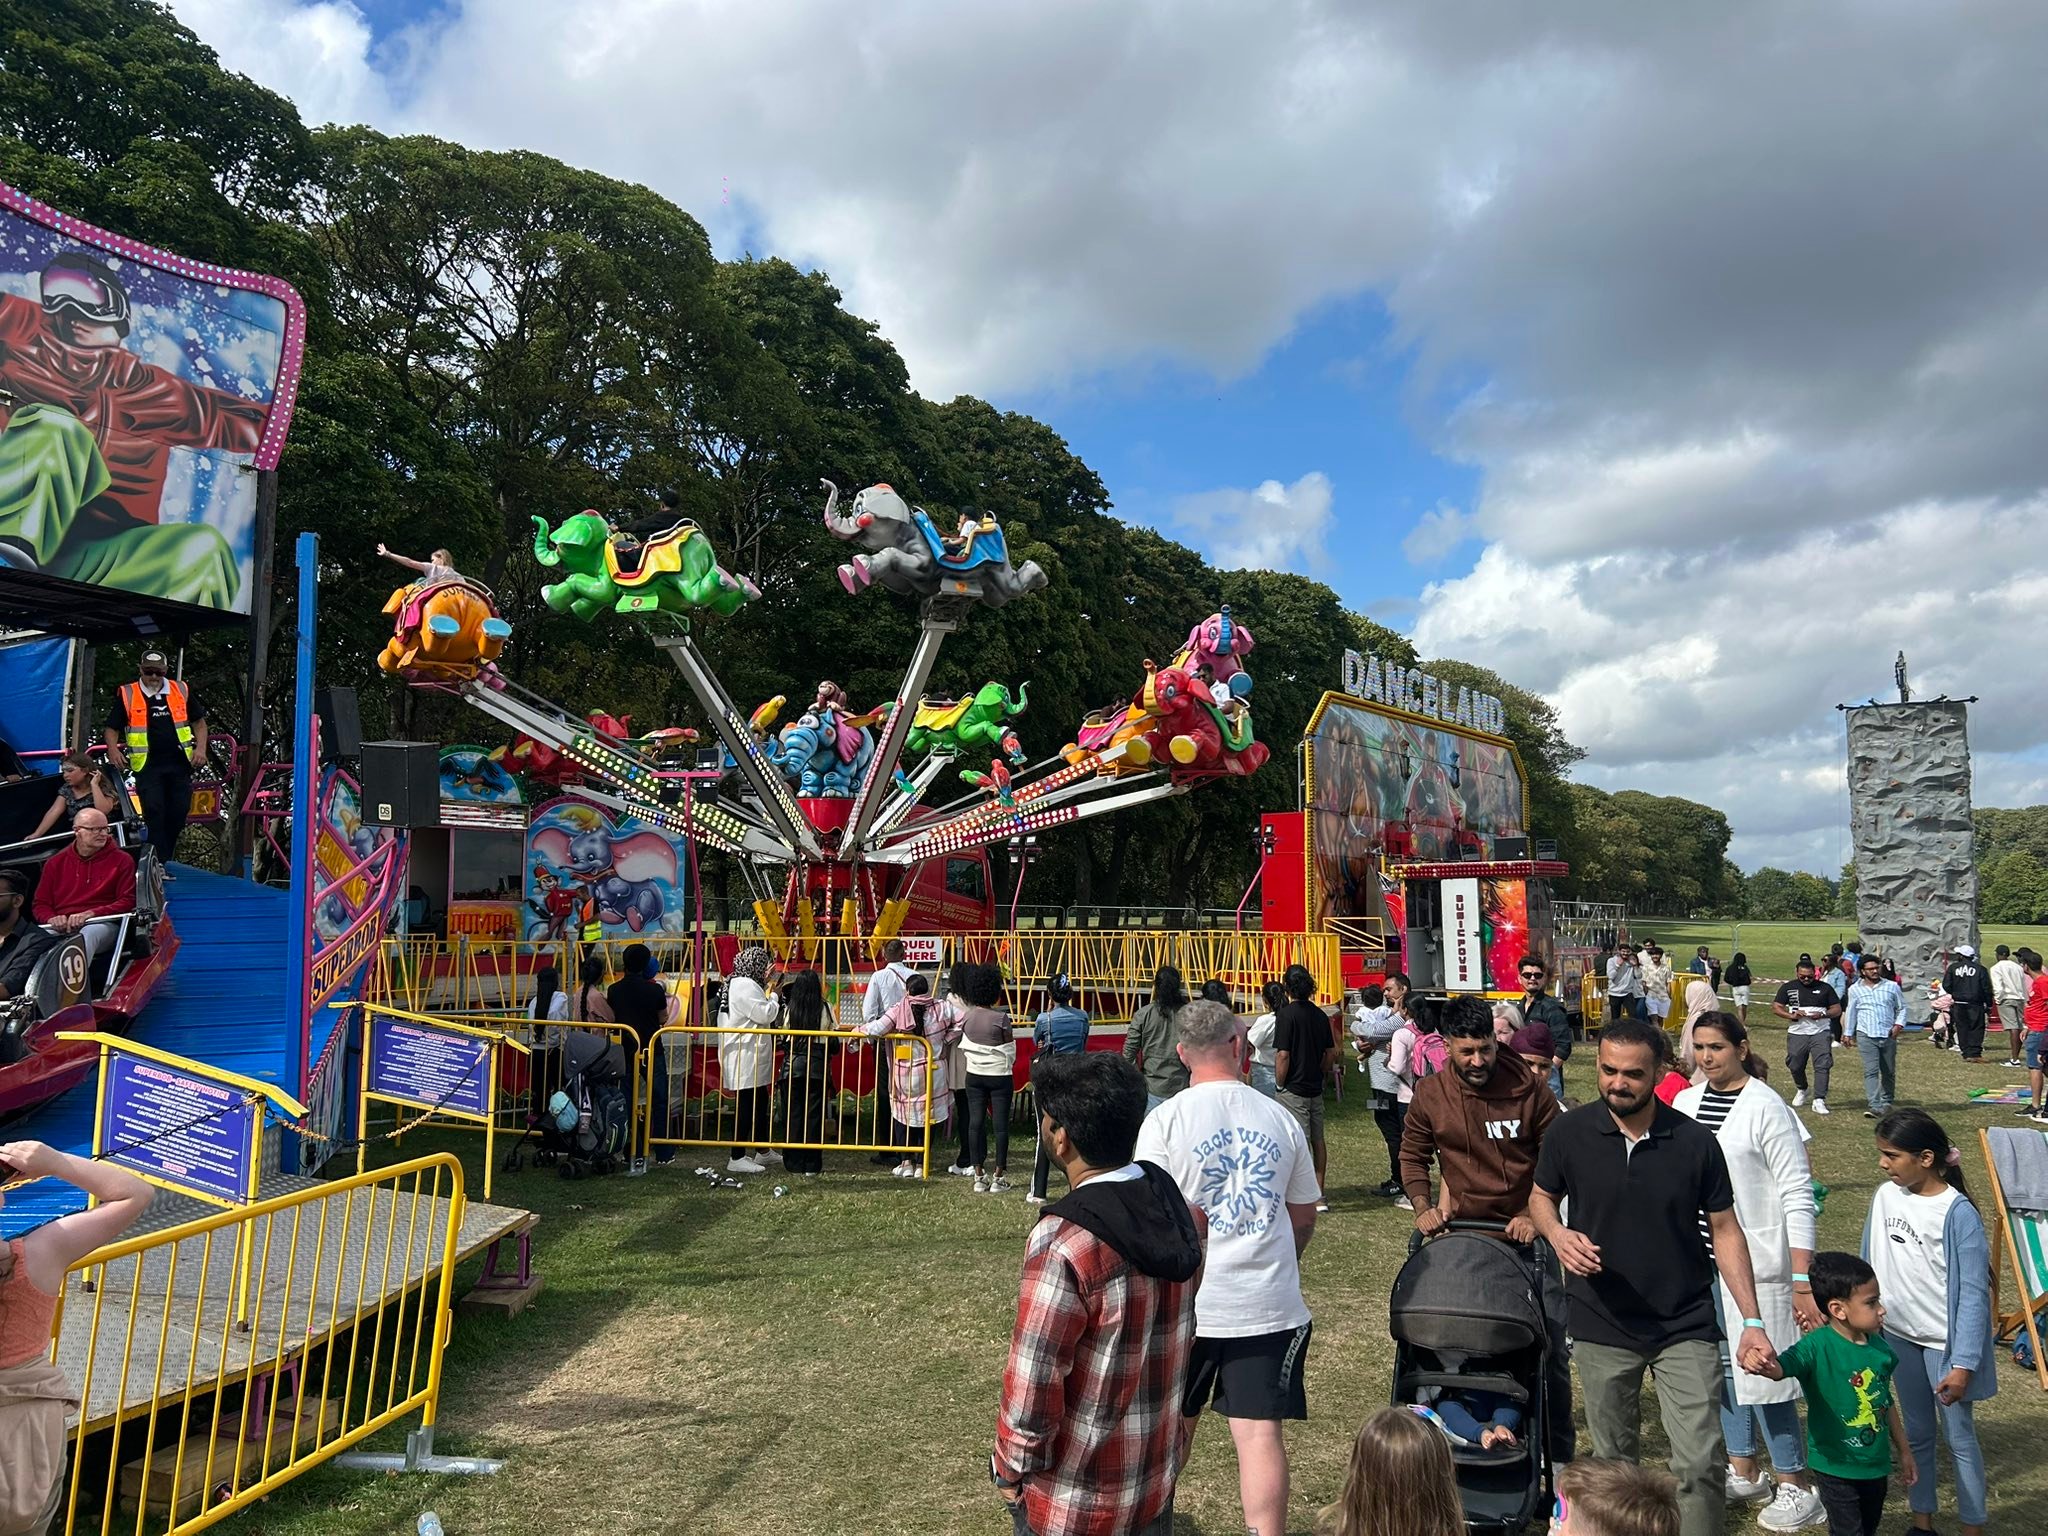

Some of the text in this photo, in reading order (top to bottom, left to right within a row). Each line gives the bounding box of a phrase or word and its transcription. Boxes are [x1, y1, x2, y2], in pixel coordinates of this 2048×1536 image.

[1344, 648, 1505, 735] DANCELAND
[380, 806, 390, 814] DS
[63, 954, 84, 985] 19
[312, 914, 378, 1002] SUPERBOB
[904, 952, 936, 960] HERE
[133, 1065, 173, 1083] SUPERBOB
[175, 1077, 202, 1093] SAFETY
[201, 1084, 230, 1101] NOTICE
[1193, 1127, 1281, 1163] Jack Wills
[1485, 1120, 1521, 1139] NY
